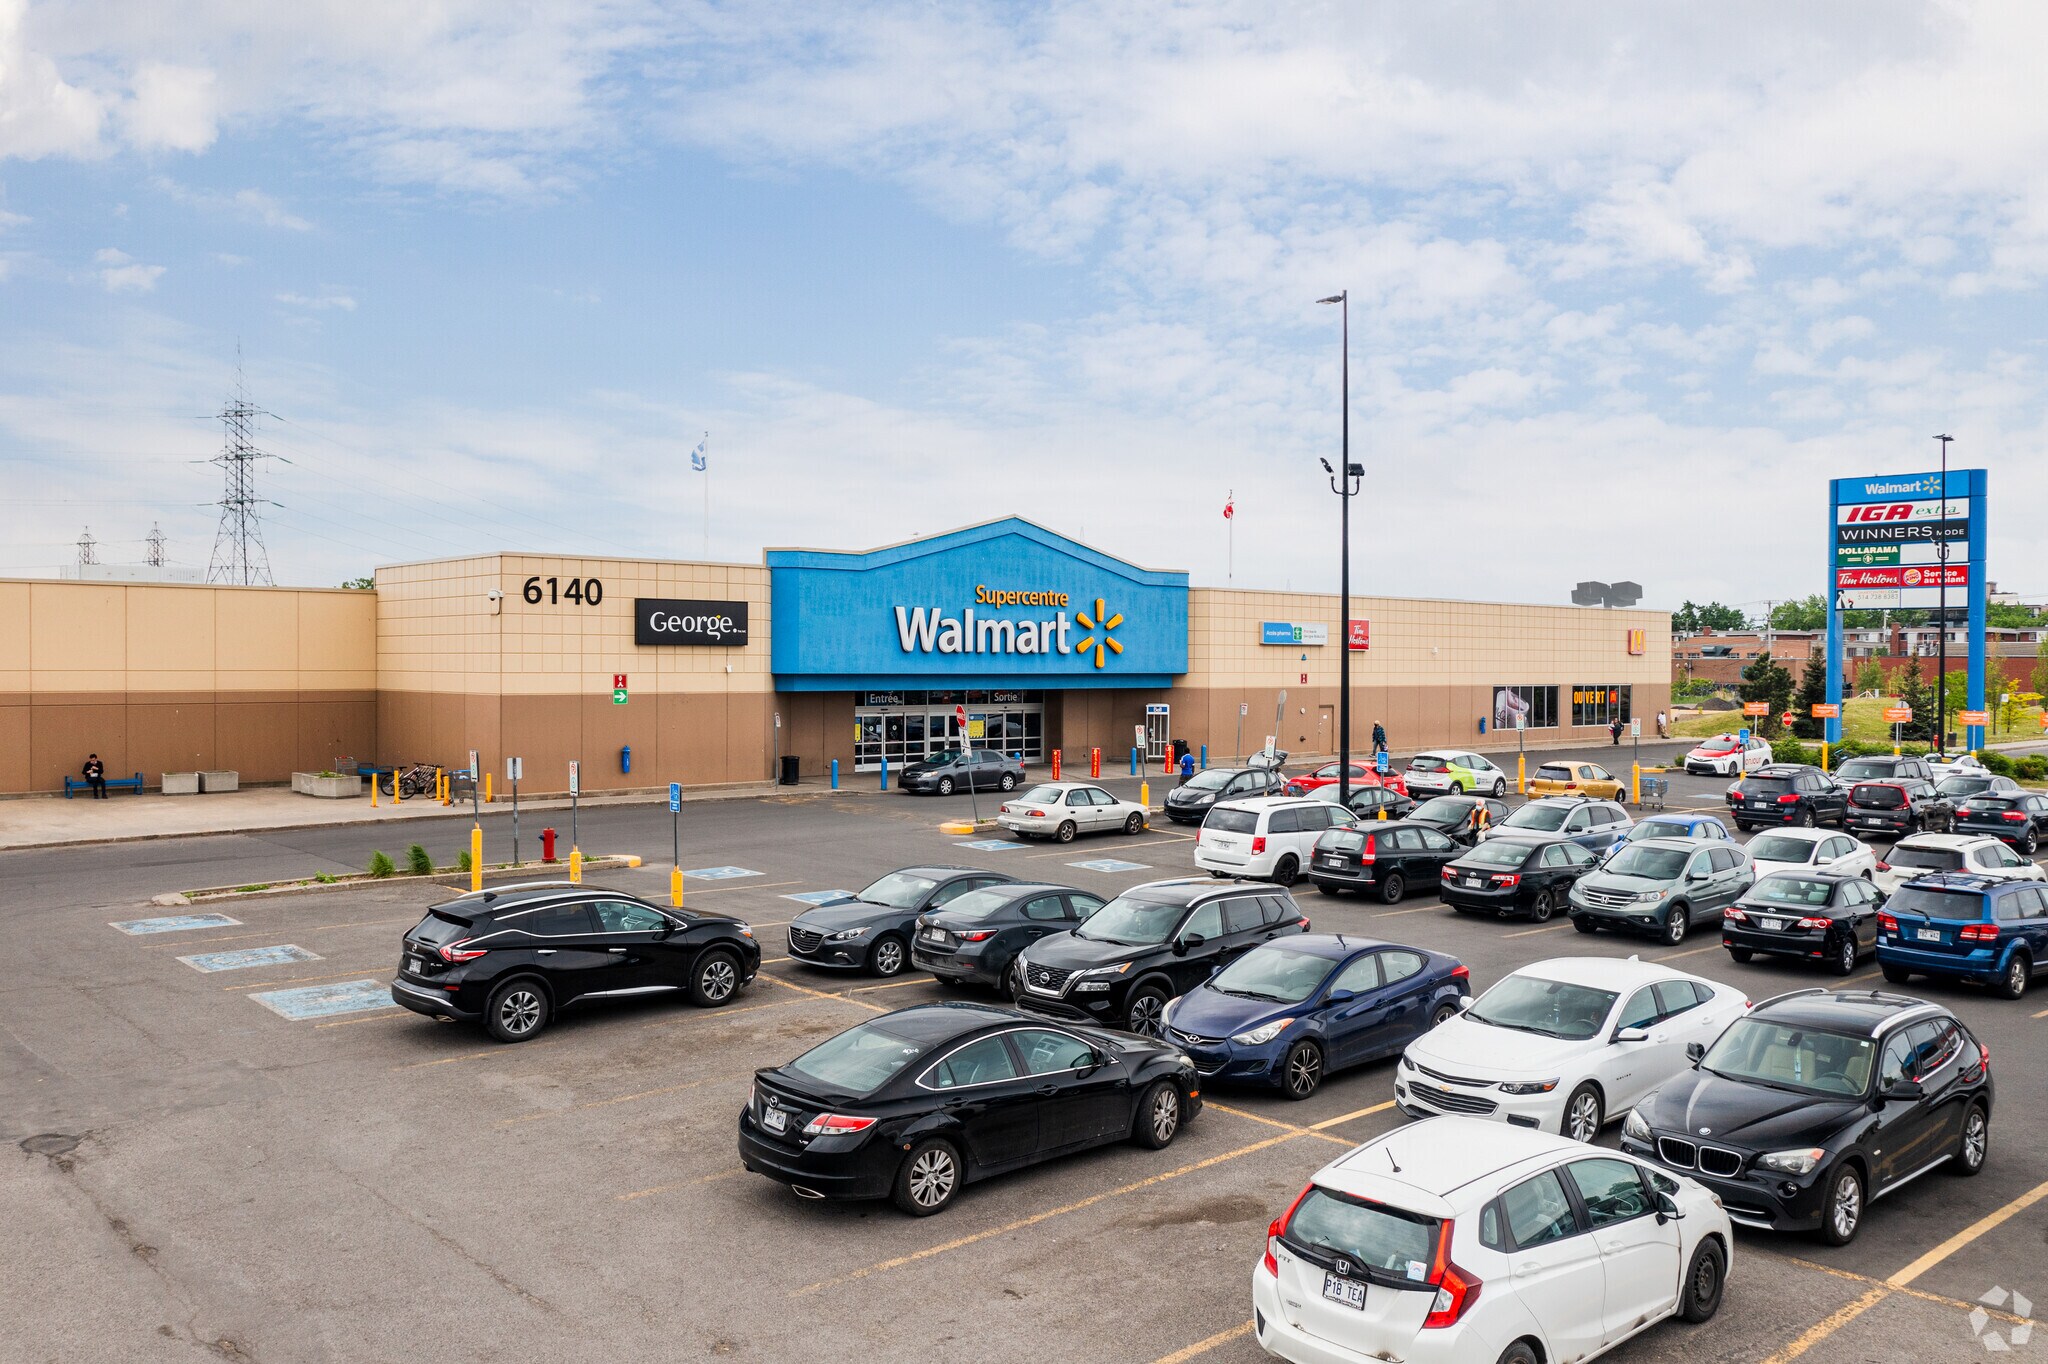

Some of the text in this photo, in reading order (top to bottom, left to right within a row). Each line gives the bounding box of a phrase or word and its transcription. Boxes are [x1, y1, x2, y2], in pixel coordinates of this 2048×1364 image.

[1865, 480, 1921, 495] Walmart
[1846, 504, 1914, 522] IGA
[1841, 526, 1965, 540] WINNERS MODE
[1838, 546, 1899, 555] DOLLARAMA
[1839, 572, 1857, 586] Tim
[522, 576, 603, 606] 6140
[975, 584, 1069, 609] Supercentre
[893, 605, 1071, 654] Walmart
[870, 692, 898, 704] Entrée
[994, 692, 1018, 702] Sortie
[1573, 691, 1605, 704] OUVERT
[1278, 1253, 1293, 1264] FIT
[1325, 1278, 1342, 1296] P18
[1347, 1285, 1363, 1303] TEA
